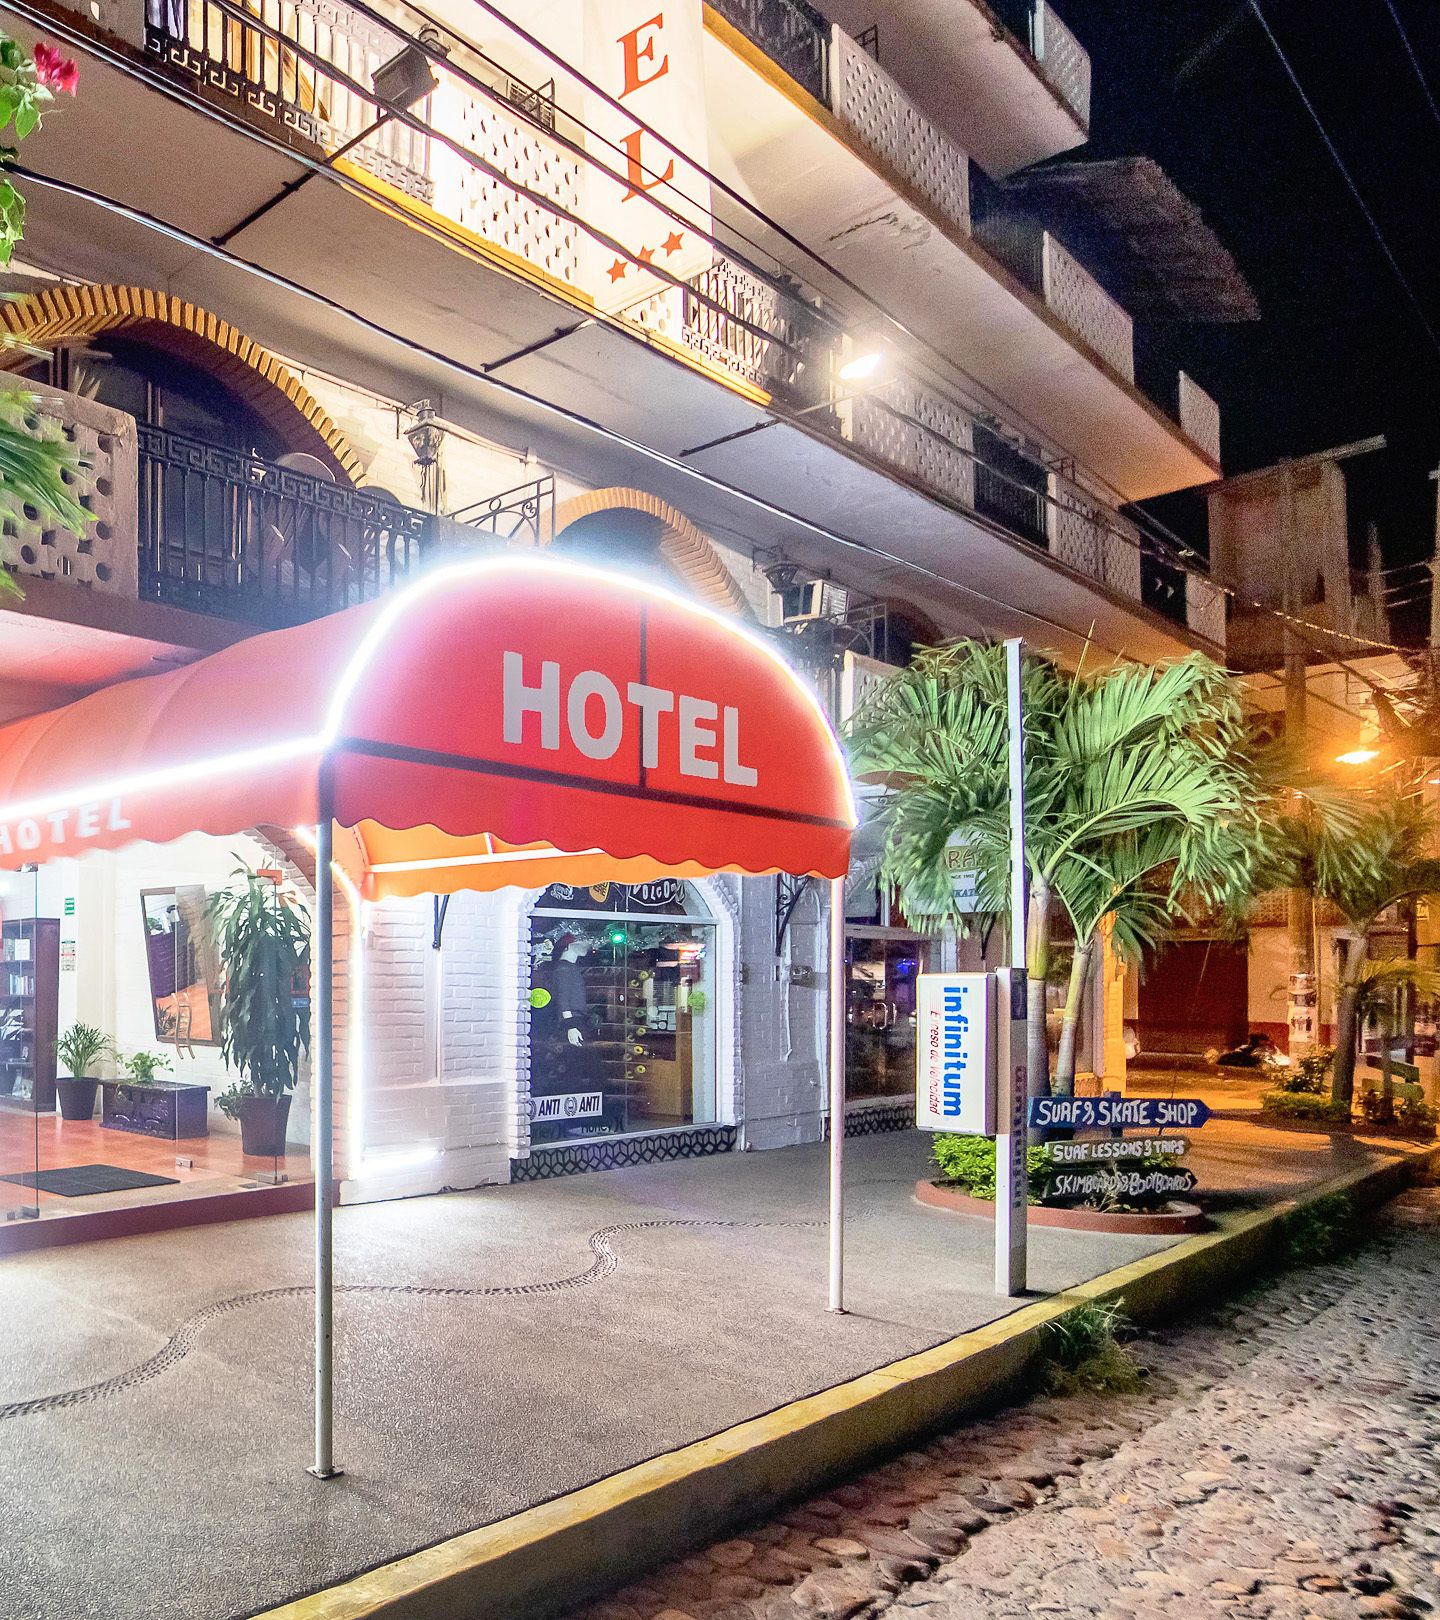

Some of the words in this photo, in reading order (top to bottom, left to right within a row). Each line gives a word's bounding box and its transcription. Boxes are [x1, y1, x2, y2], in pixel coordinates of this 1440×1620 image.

[503, 650, 758, 787] HOTEL
[930, 1010, 941, 1047] Eceso
[943, 986, 968, 1117] infinitum
[538, 1099, 561, 1116] ANTI
[579, 1096, 601, 1113] ANTI
[1036, 1101, 1082, 1126] SURF
[1097, 1100, 1151, 1126] SKATE
[1155, 1102, 1199, 1125] SHOP
[1053, 1143, 1089, 1161] SURF
[1092, 1140, 1144, 1158] LESSONS
[1154, 1140, 1185, 1155] TRIPS
